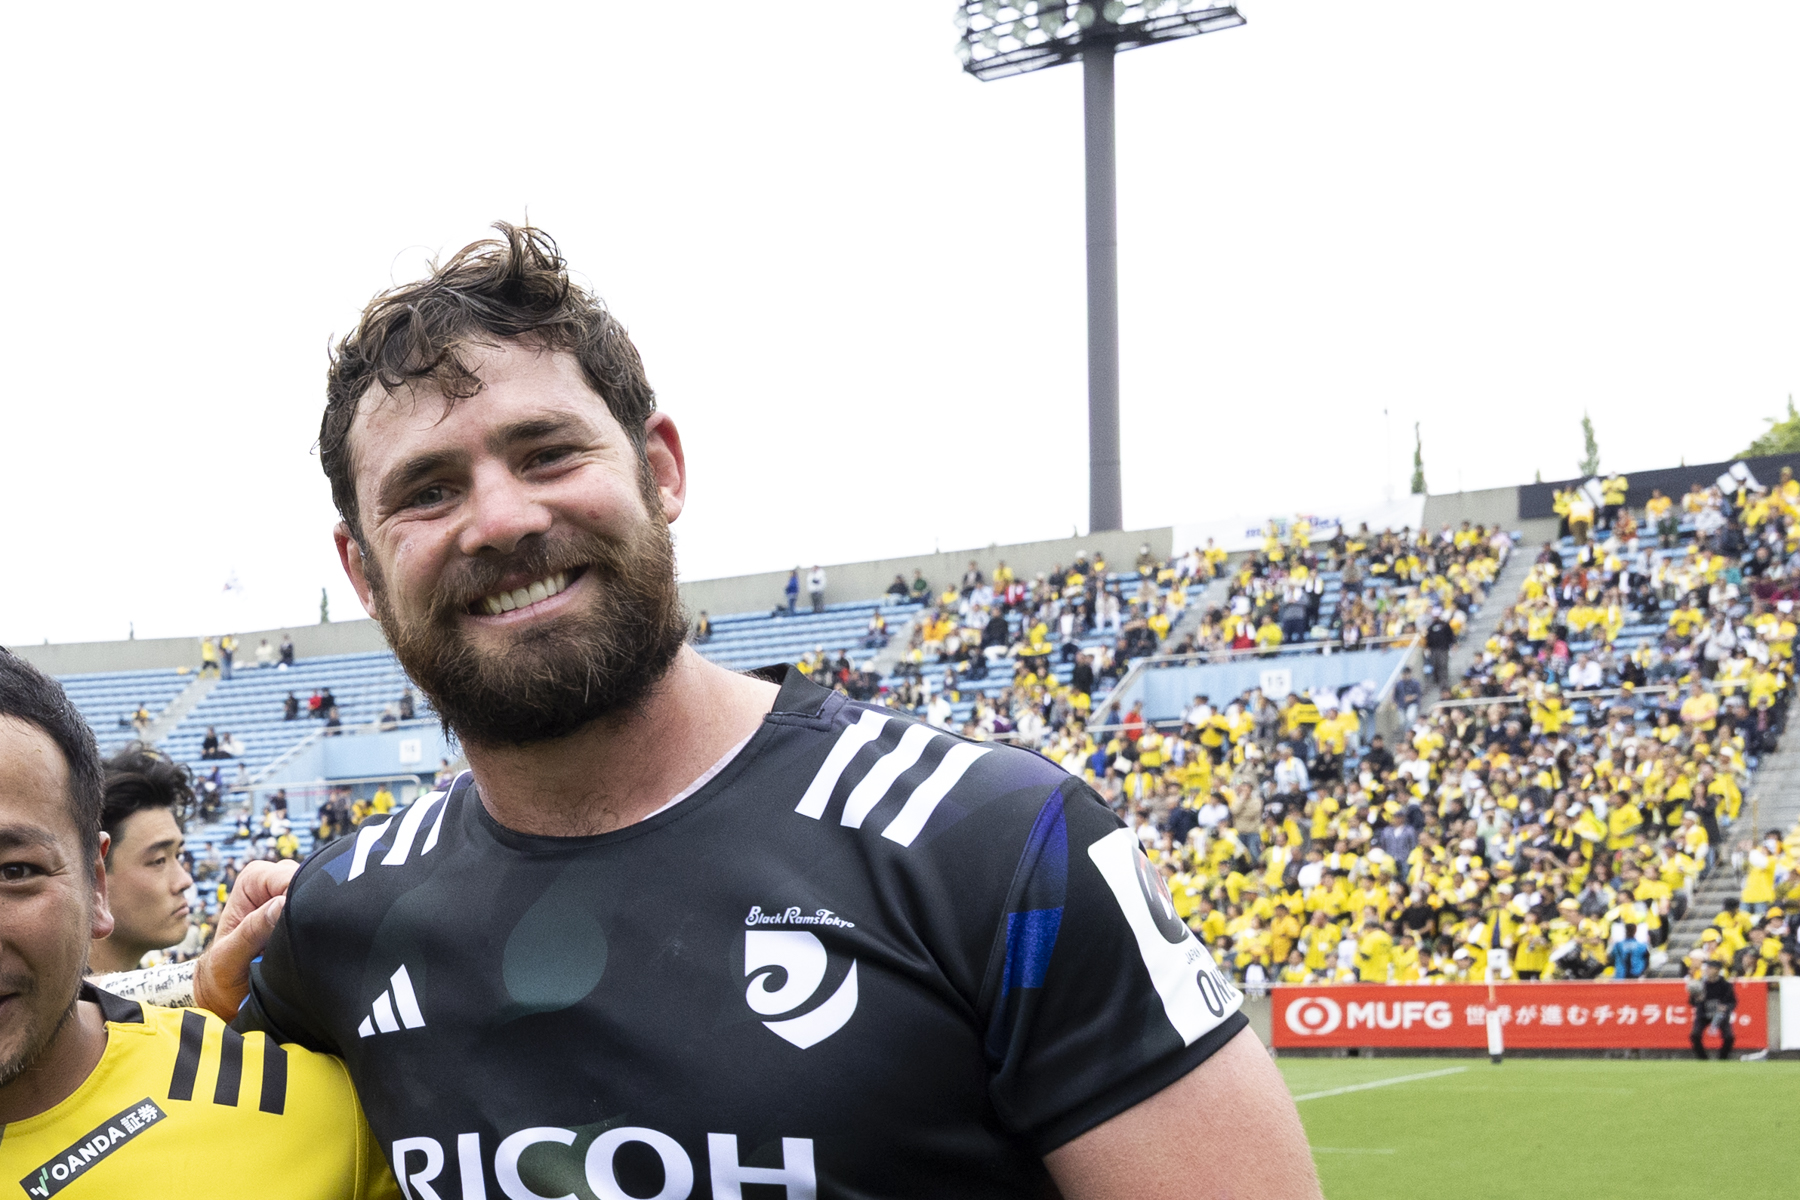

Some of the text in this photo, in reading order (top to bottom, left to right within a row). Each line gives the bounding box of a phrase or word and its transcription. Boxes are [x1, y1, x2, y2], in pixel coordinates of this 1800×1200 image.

[1346, 1000, 1453, 1029] MUFG
[50, 1103, 158, 1182] OANDA 証券
